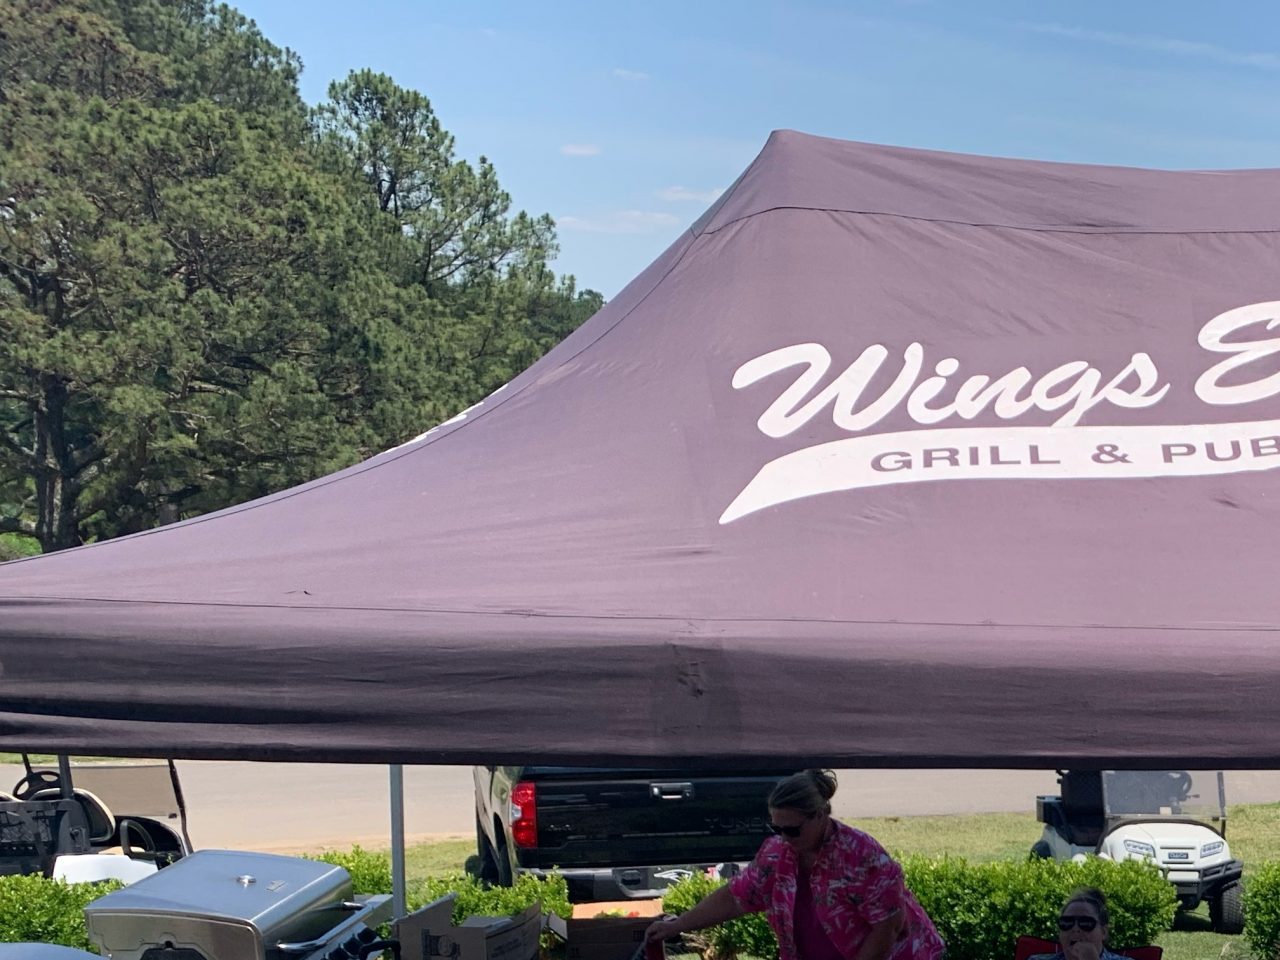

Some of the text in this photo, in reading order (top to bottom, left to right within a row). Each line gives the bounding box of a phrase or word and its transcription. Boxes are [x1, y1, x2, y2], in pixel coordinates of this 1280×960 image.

[732, 342, 1170, 438] Wings
[870, 443, 1060, 473] GRILL
[1091, 443, 1133, 465] &
